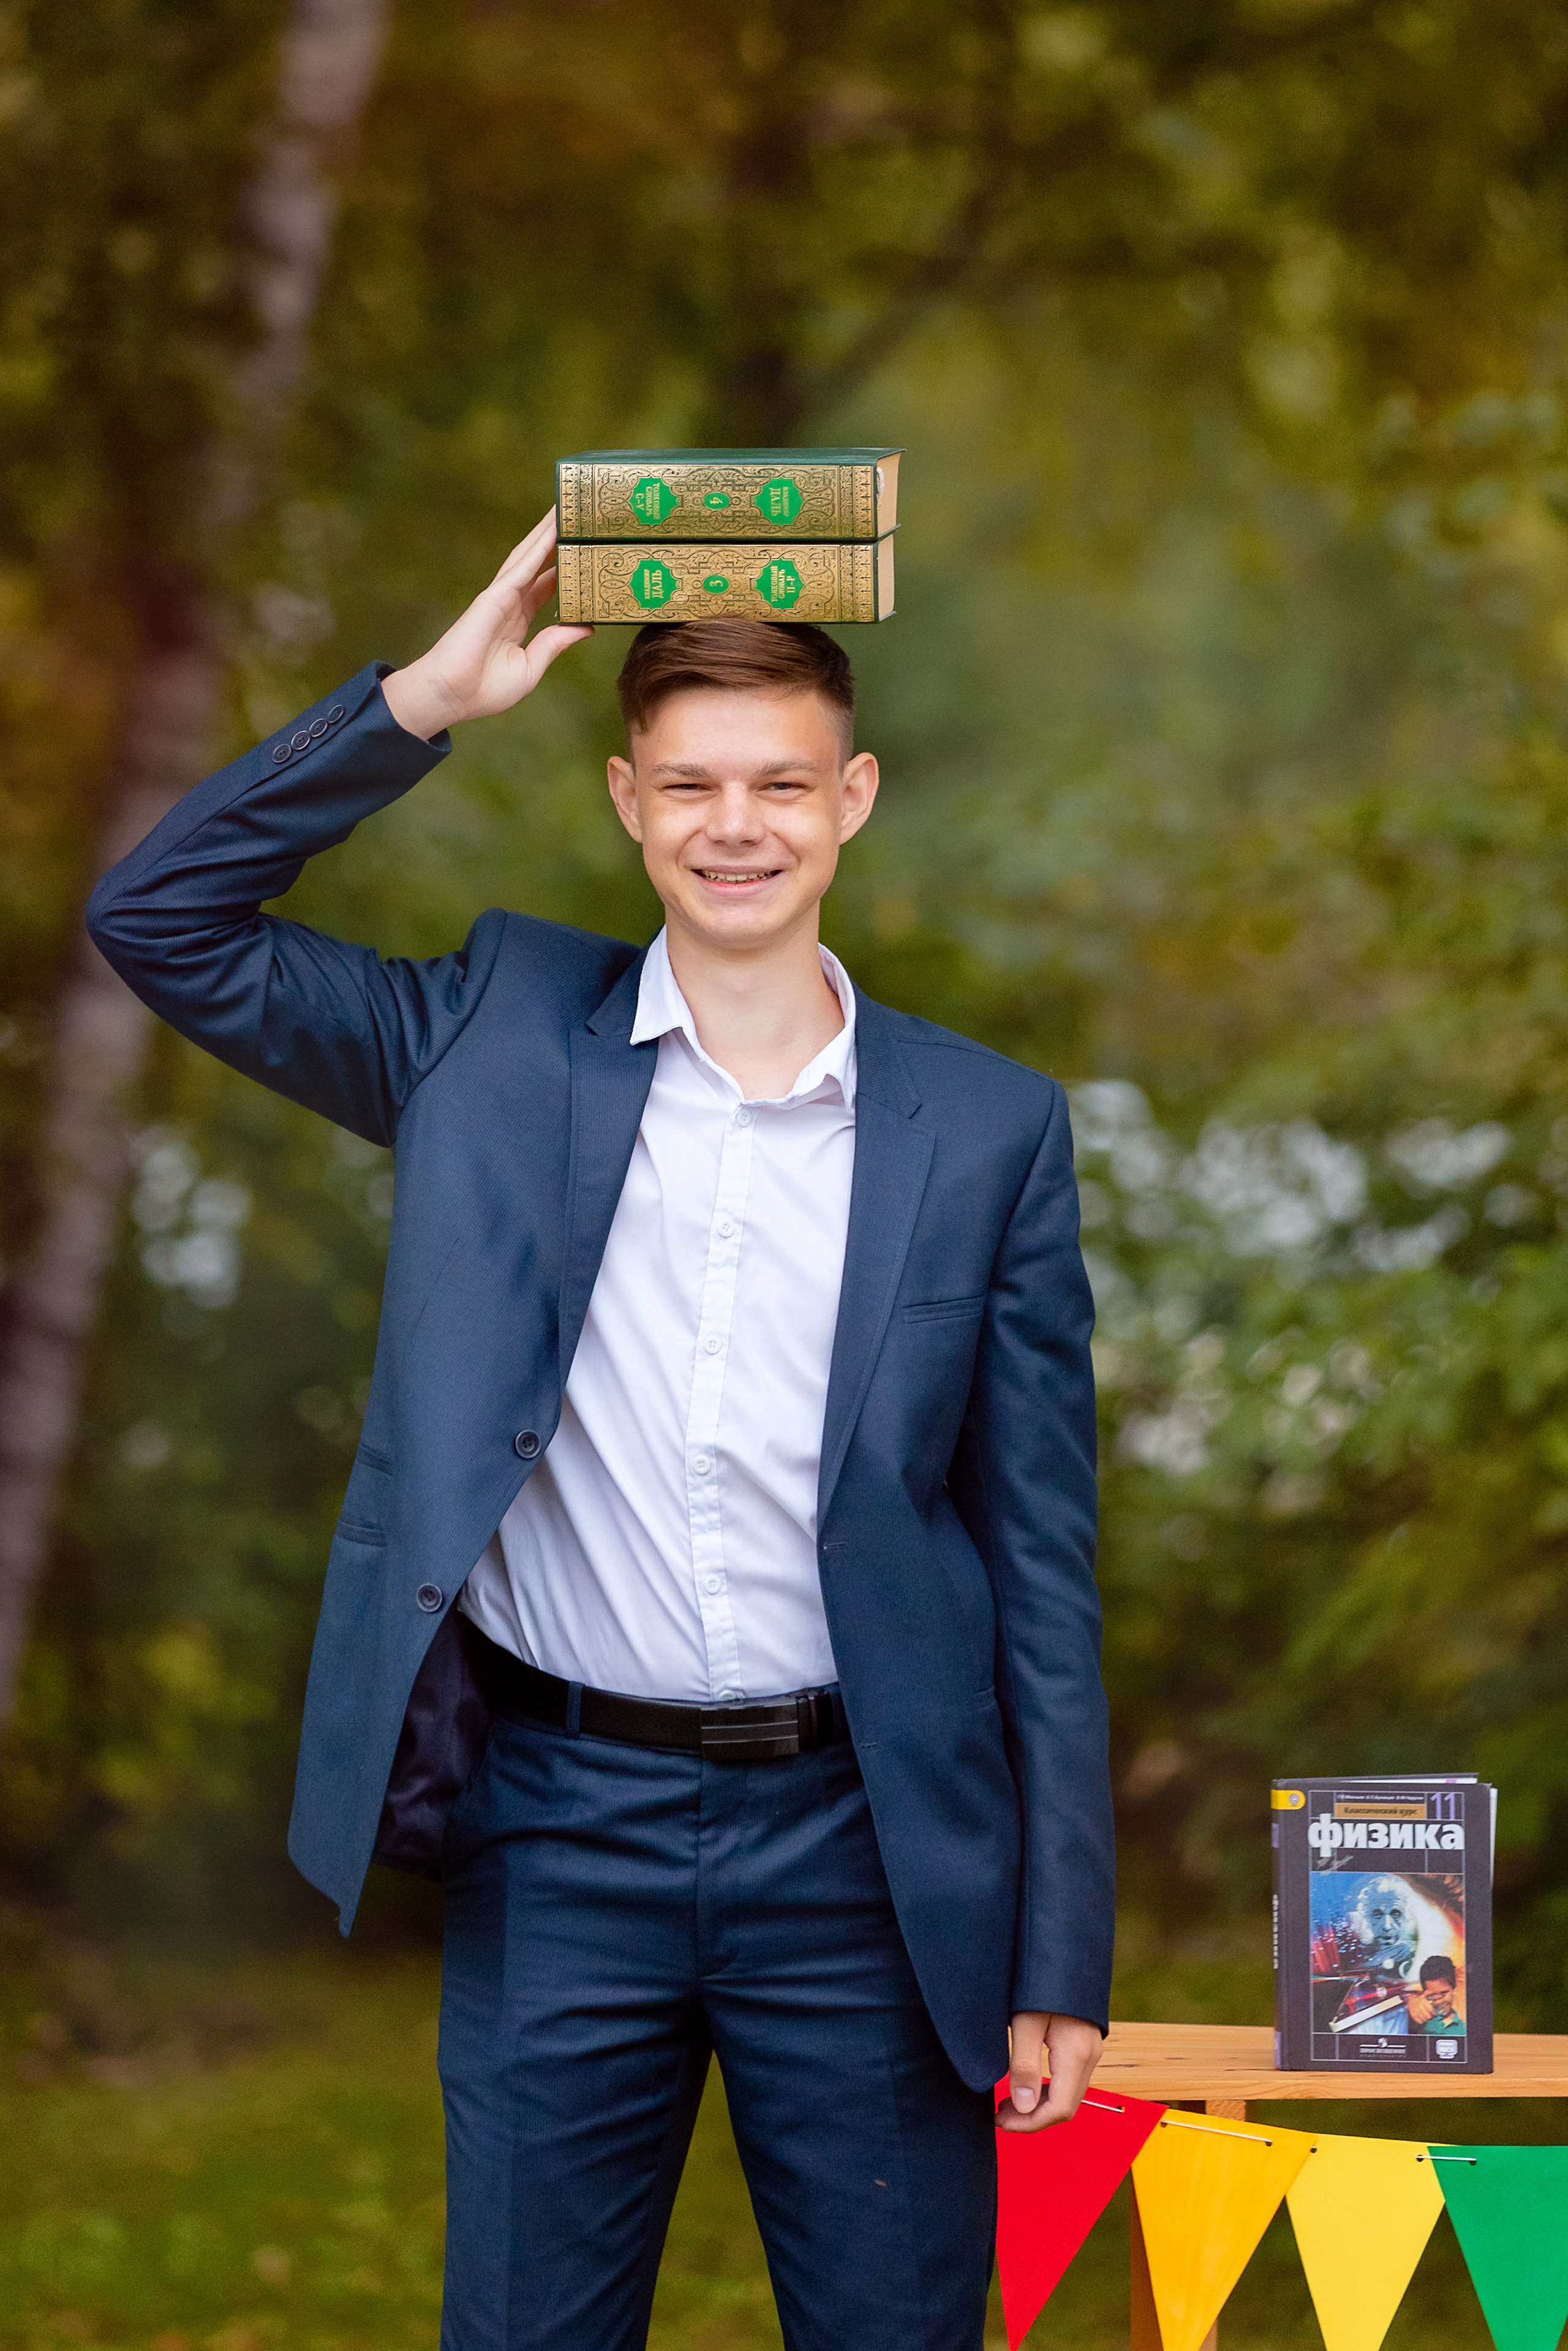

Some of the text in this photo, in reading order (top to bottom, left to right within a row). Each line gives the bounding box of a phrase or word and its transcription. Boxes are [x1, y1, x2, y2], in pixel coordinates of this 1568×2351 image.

[770, 487, 781, 516] ДАЛЬ
[651, 570, 664, 598] ДАЛЬ
[1430, 1792, 1455, 1820] 11
[1308, 1813, 1465, 1857] физика
